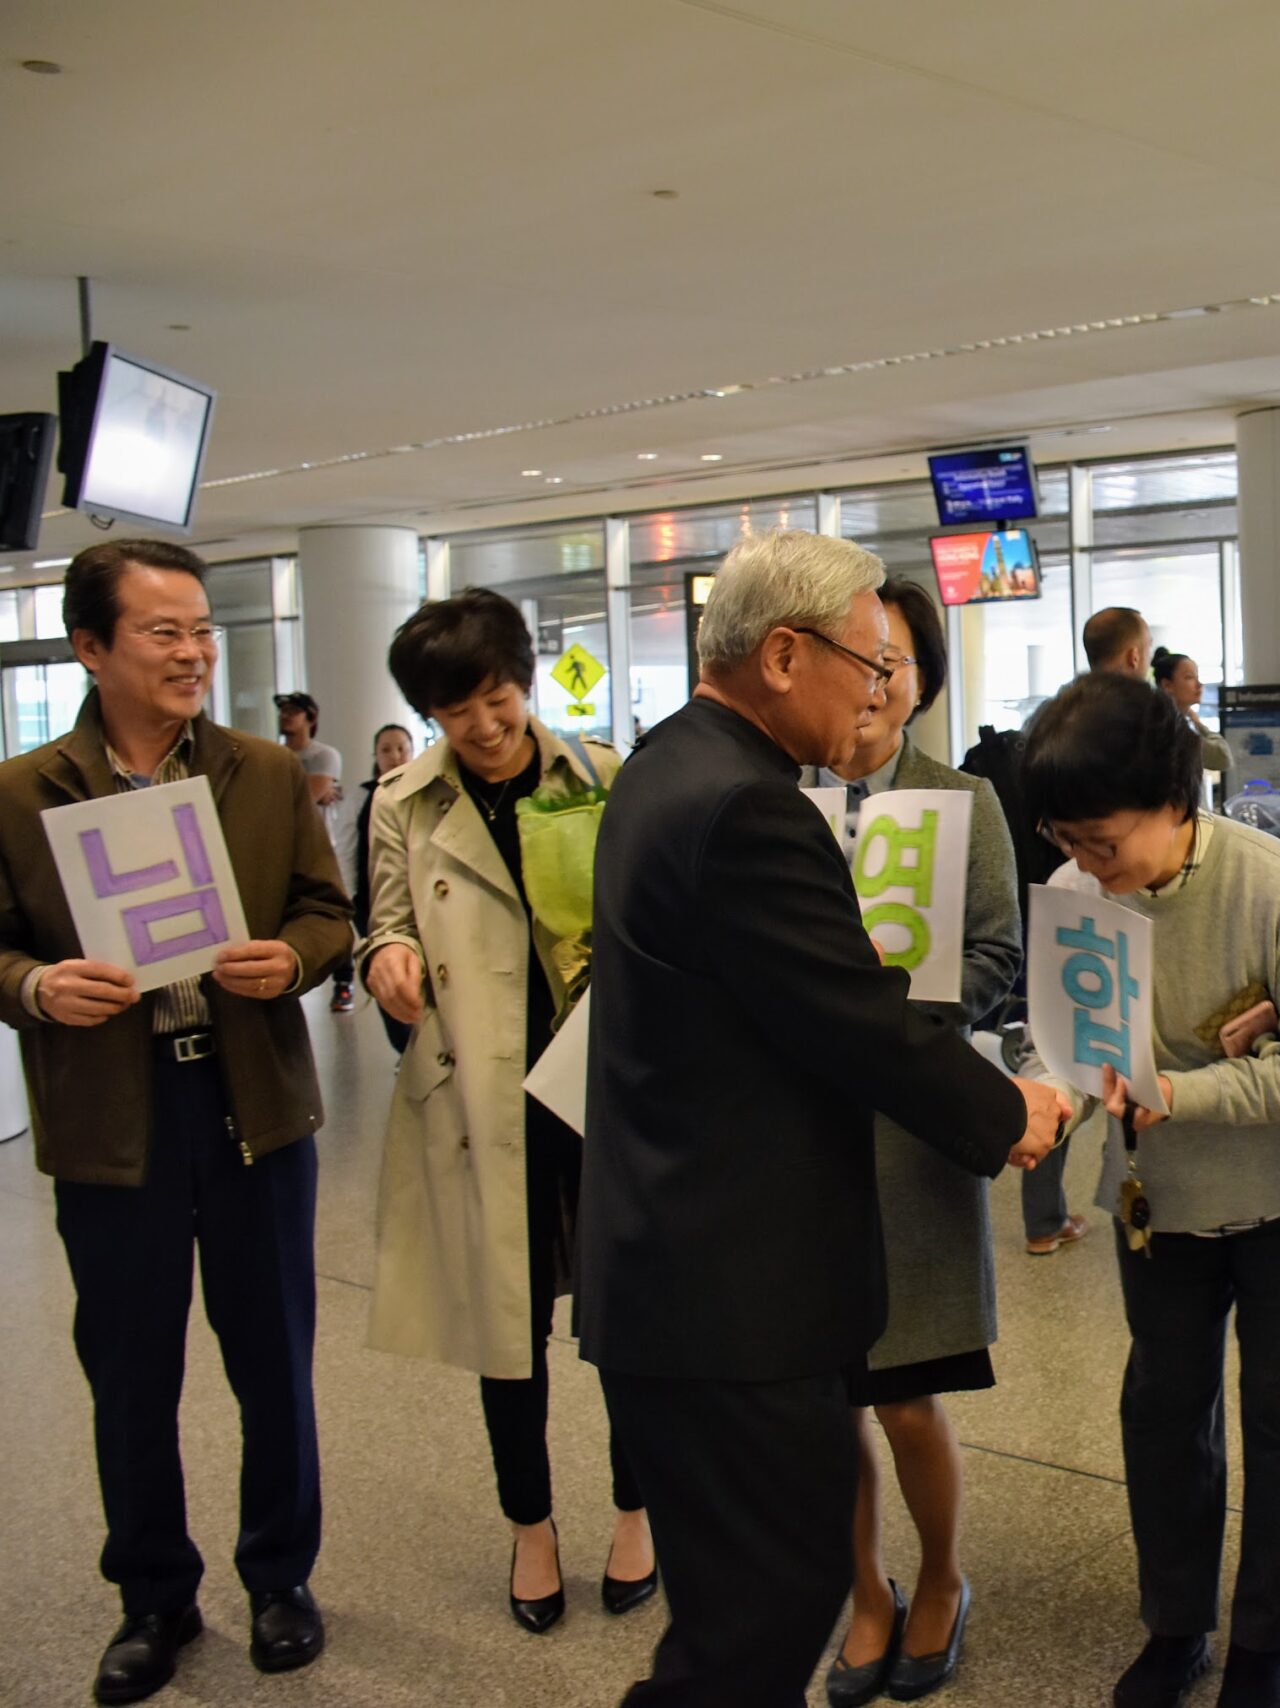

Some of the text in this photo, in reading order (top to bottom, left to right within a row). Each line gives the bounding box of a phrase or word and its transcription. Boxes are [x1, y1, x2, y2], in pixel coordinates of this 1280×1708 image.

[79, 802, 229, 967] 님
[854, 809, 939, 972] 영
[1056, 916, 1140, 1080] 합
